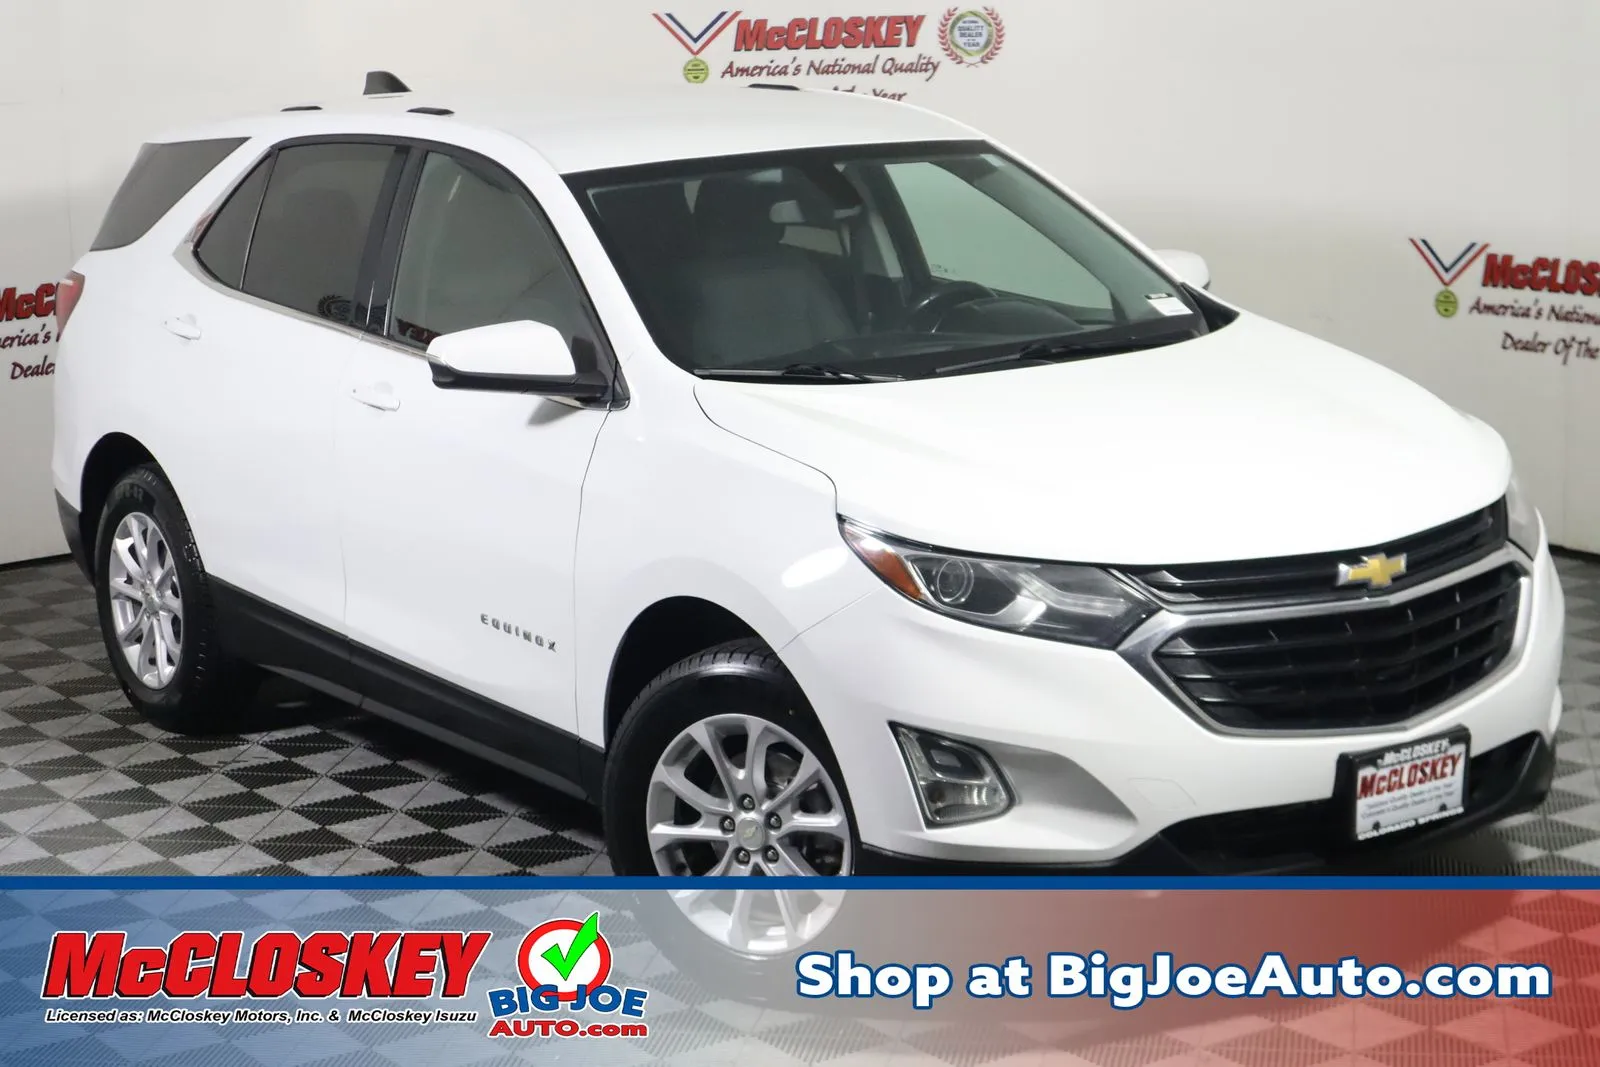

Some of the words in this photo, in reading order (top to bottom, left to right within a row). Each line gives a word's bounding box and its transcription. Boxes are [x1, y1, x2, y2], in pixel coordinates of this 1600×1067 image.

[734, 15, 926, 51] McCLOSKEY
[721, 57, 802, 78] America's
[806, 54, 880, 76] National
[882, 53, 940, 81] Quality
[1481, 252, 1600, 298] McCLOS
[1468, 296, 1544, 321] America's
[0, 323, 51, 349] erica's
[1501, 330, 1551, 353] Dealer
[480, 612, 557, 653] EQUINOX
[1358, 751, 1462, 800] McCLOSKEY
